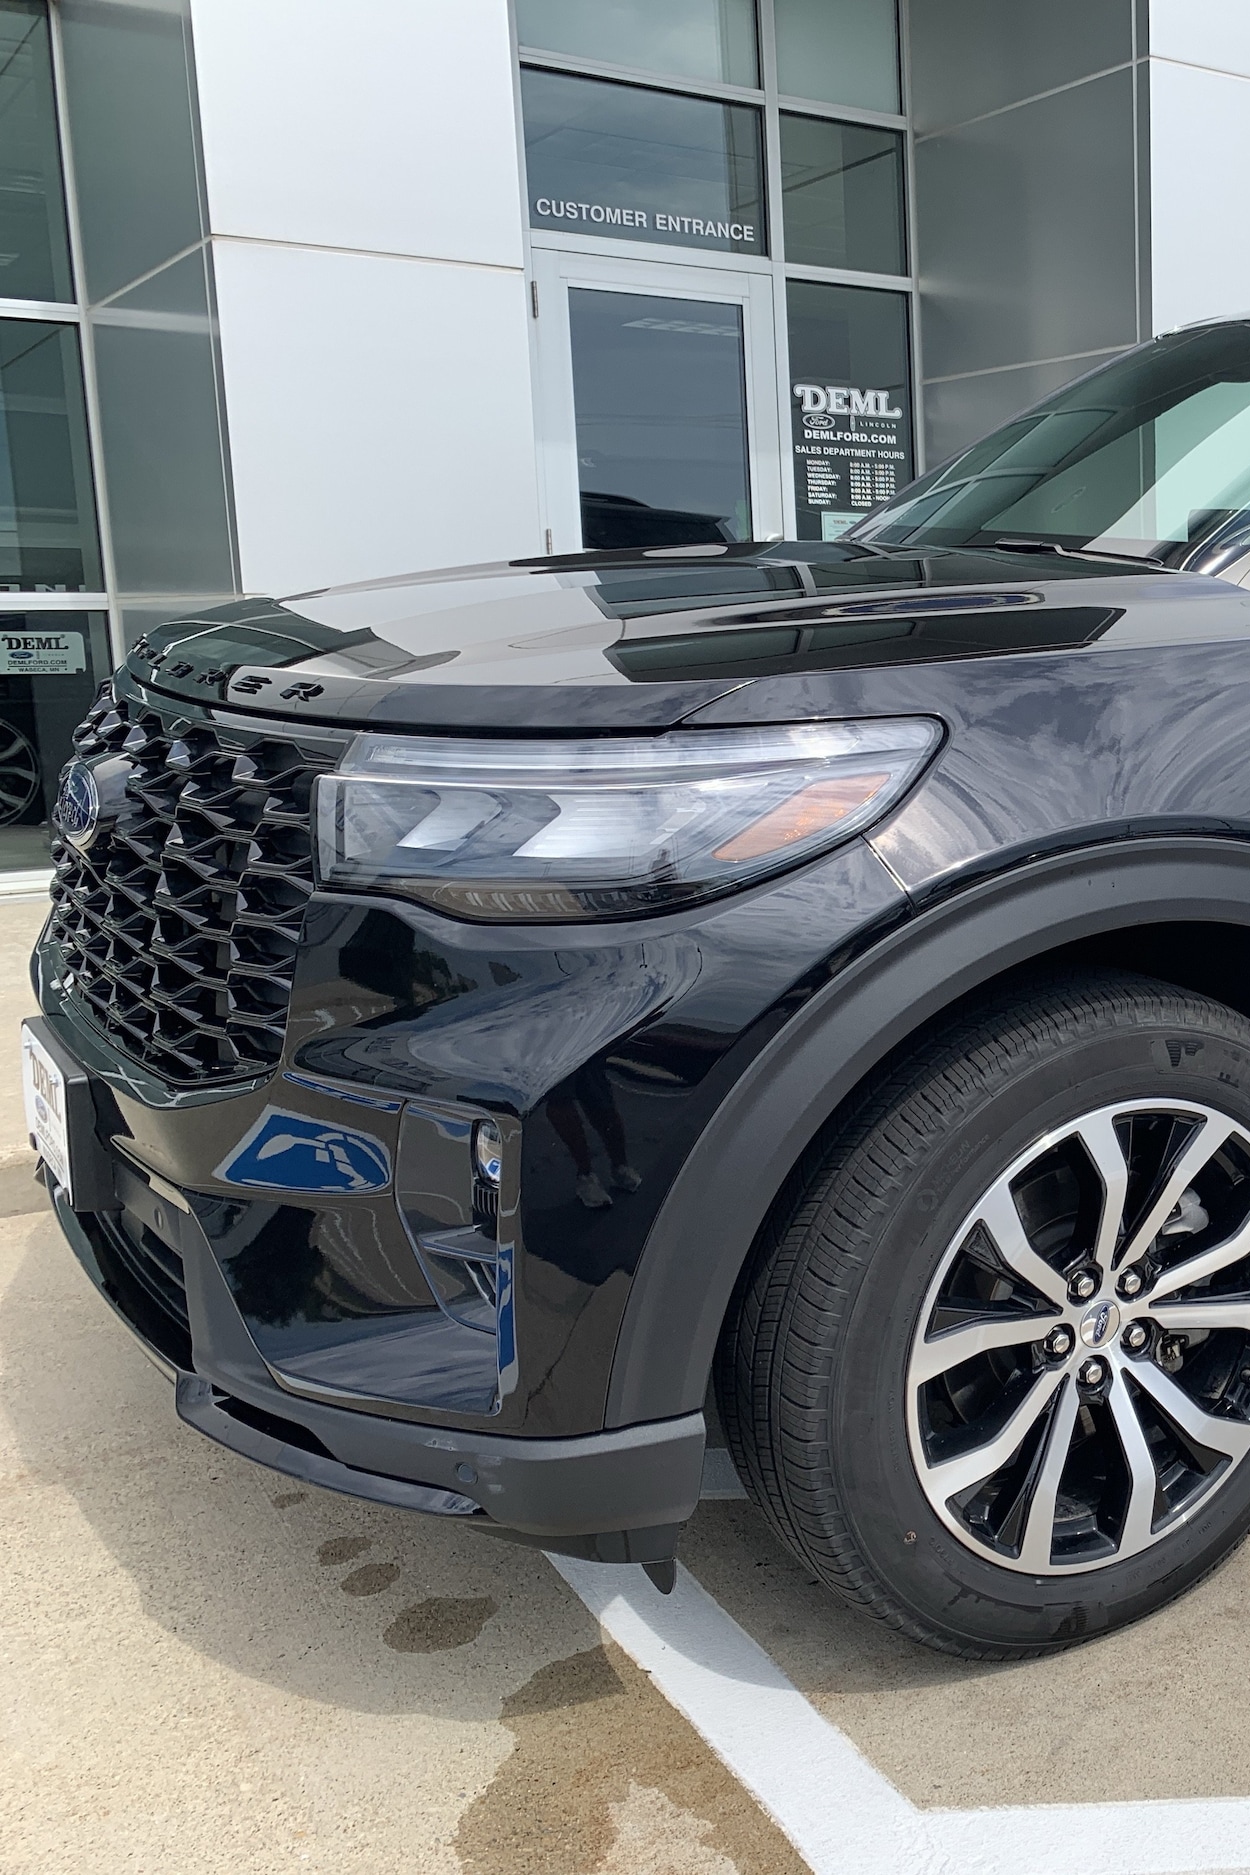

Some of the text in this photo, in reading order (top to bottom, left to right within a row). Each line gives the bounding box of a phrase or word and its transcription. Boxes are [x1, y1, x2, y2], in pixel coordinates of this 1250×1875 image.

[536, 198, 755, 242] CUSTOMER ENTRANCE
[793, 384, 902, 419] DEML
[809, 416, 829, 427] Ford
[860, 421, 897, 429] LINCOLN
[804, 429, 897, 445] DEMLFORD.COM
[795, 445, 905, 460] SALES DEPARTMENT HOURS
[807, 472, 841, 480] WEDNESDAY:
[808, 491, 837, 499] SATURDAY:
[1, 637, 69, 650] DEML
